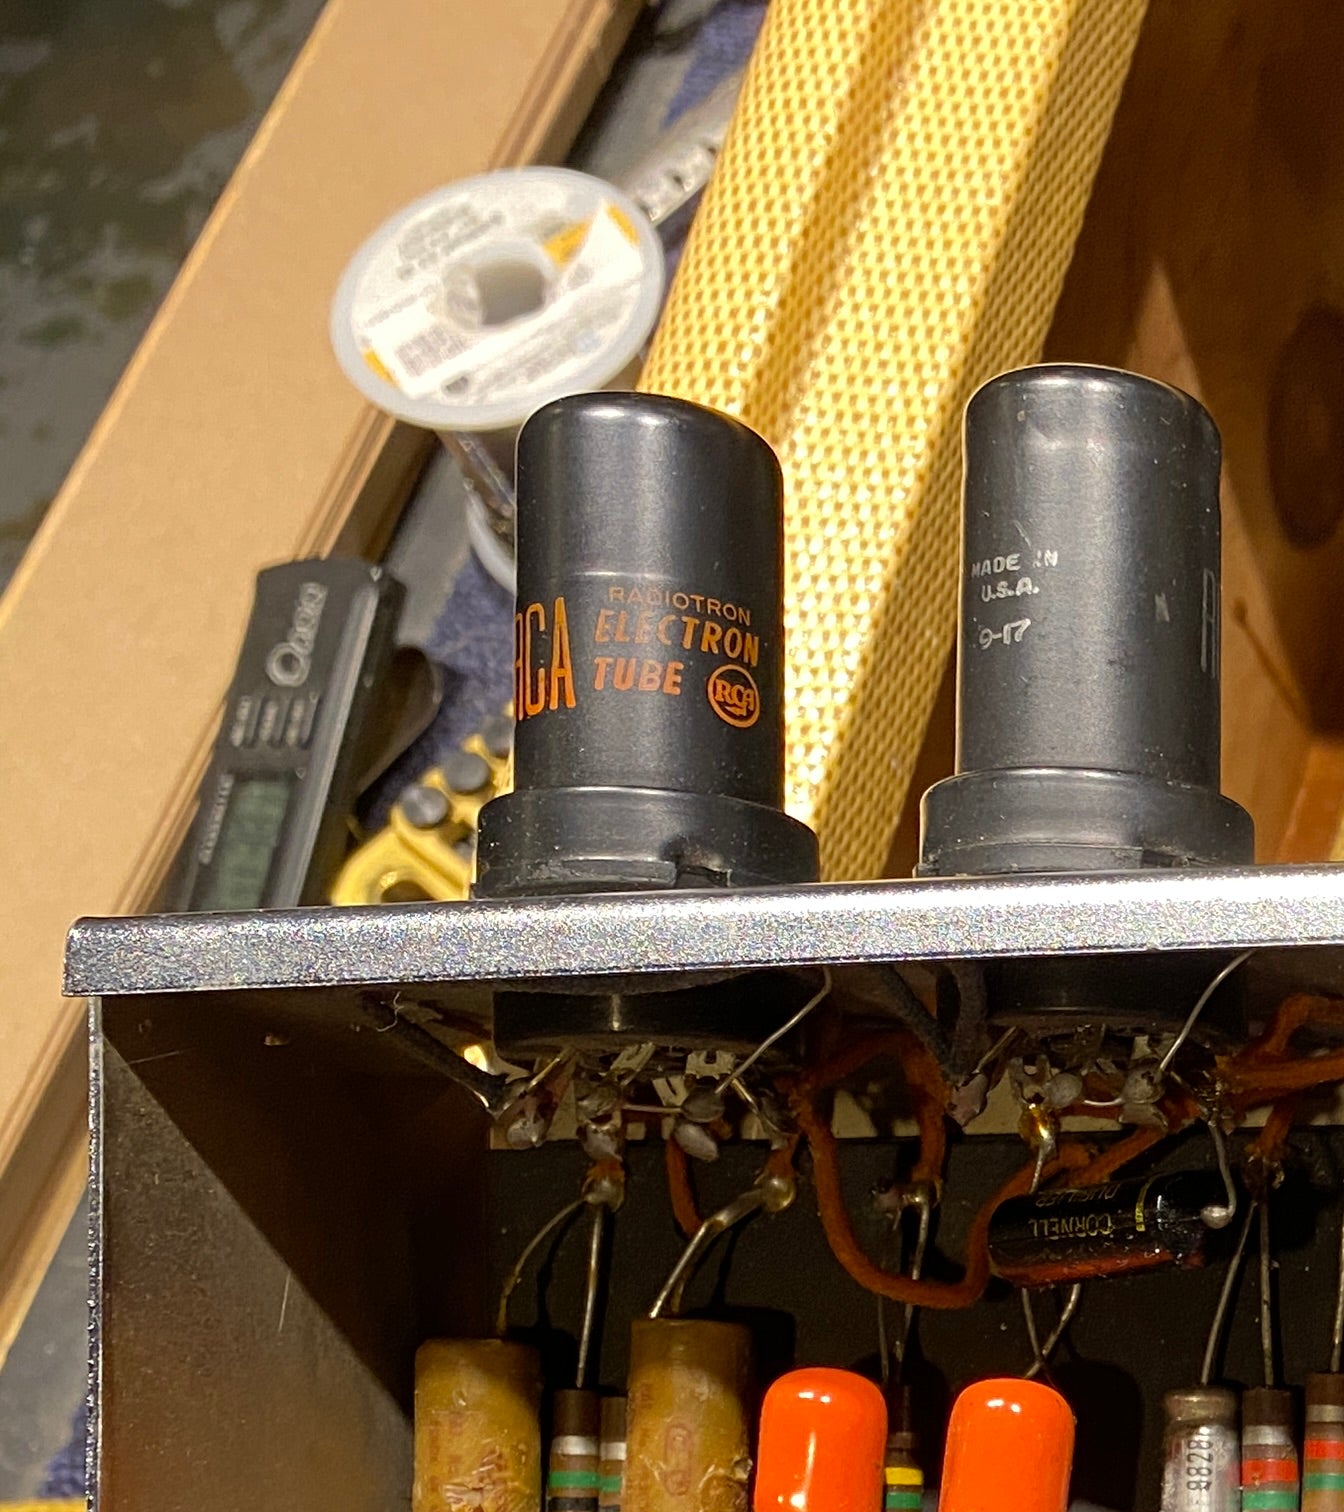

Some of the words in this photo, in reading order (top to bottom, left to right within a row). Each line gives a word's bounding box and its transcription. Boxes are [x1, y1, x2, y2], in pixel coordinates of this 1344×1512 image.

[971, 553, 1021, 578] MADE
[608, 587, 751, 627] RADIOTRON
[981, 577, 1040, 602] U.S.A.
[594, 608, 760, 668] ELECTRON
[593, 656, 685, 697] TUBE
[713, 677, 755, 714] RCA
[1029, 1212, 1114, 1241] CORNELL
